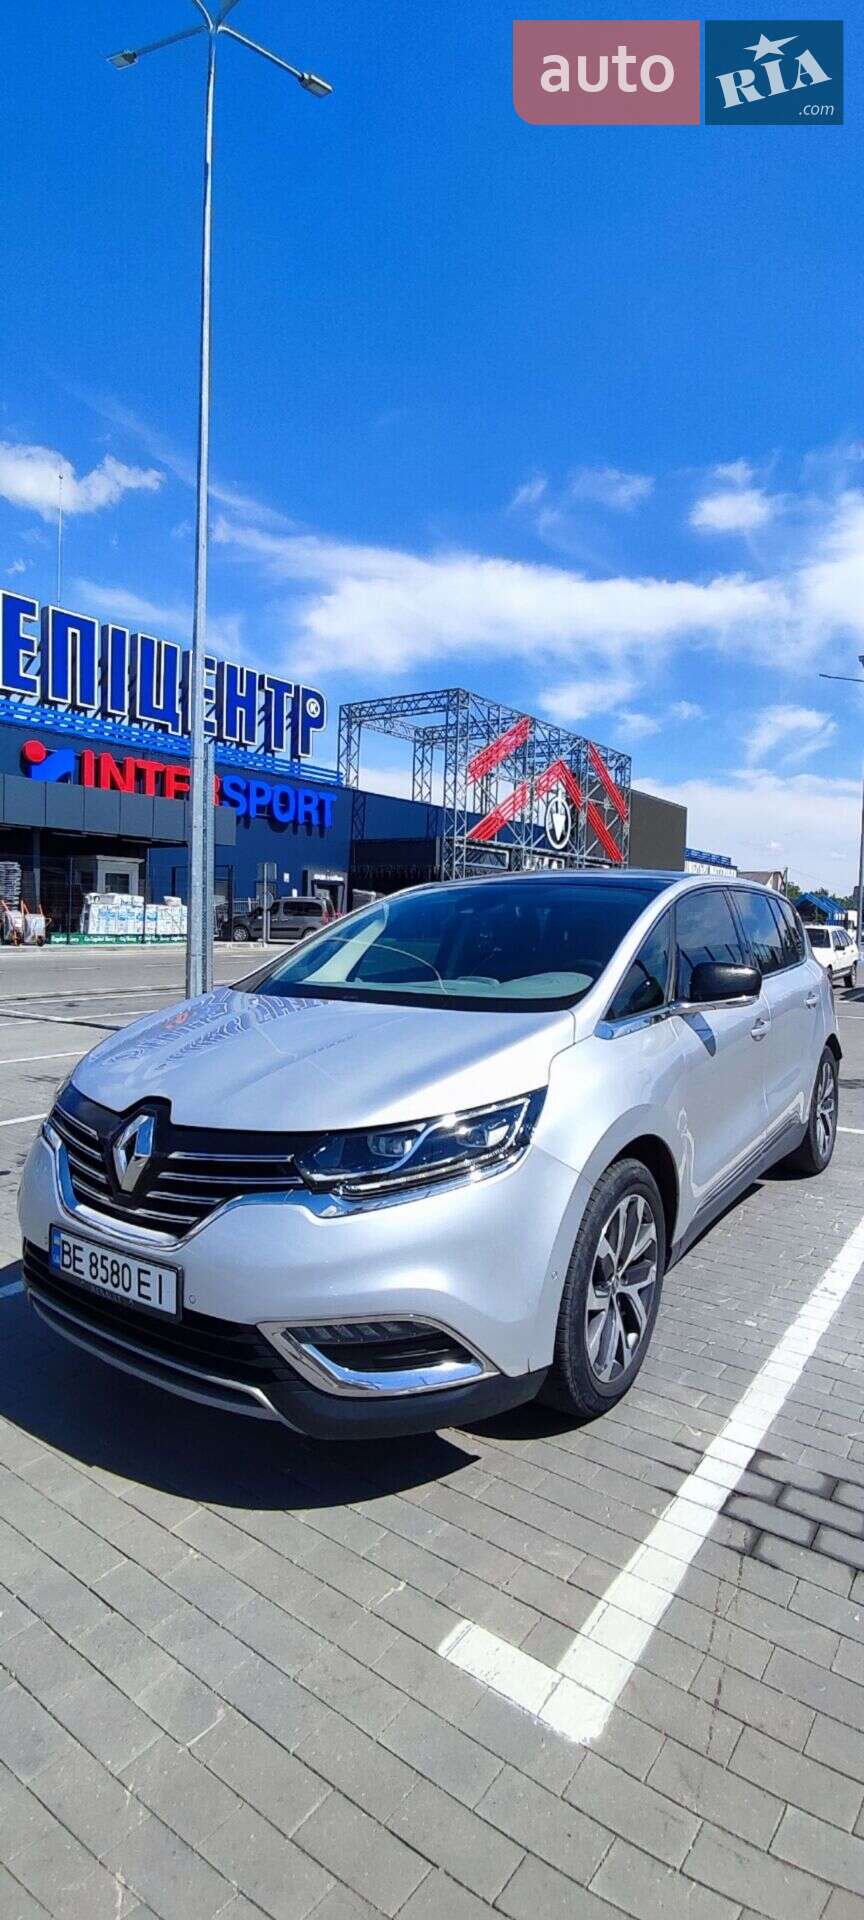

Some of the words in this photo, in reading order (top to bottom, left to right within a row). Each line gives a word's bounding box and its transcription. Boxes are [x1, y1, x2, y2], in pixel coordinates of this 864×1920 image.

[0, 589, 327, 759] ЕПІЦЕНТР
[61, 1239, 85, 1276] BE
[89, 1252, 133, 1293] 8580
[137, 1267, 163, 1305] EI
